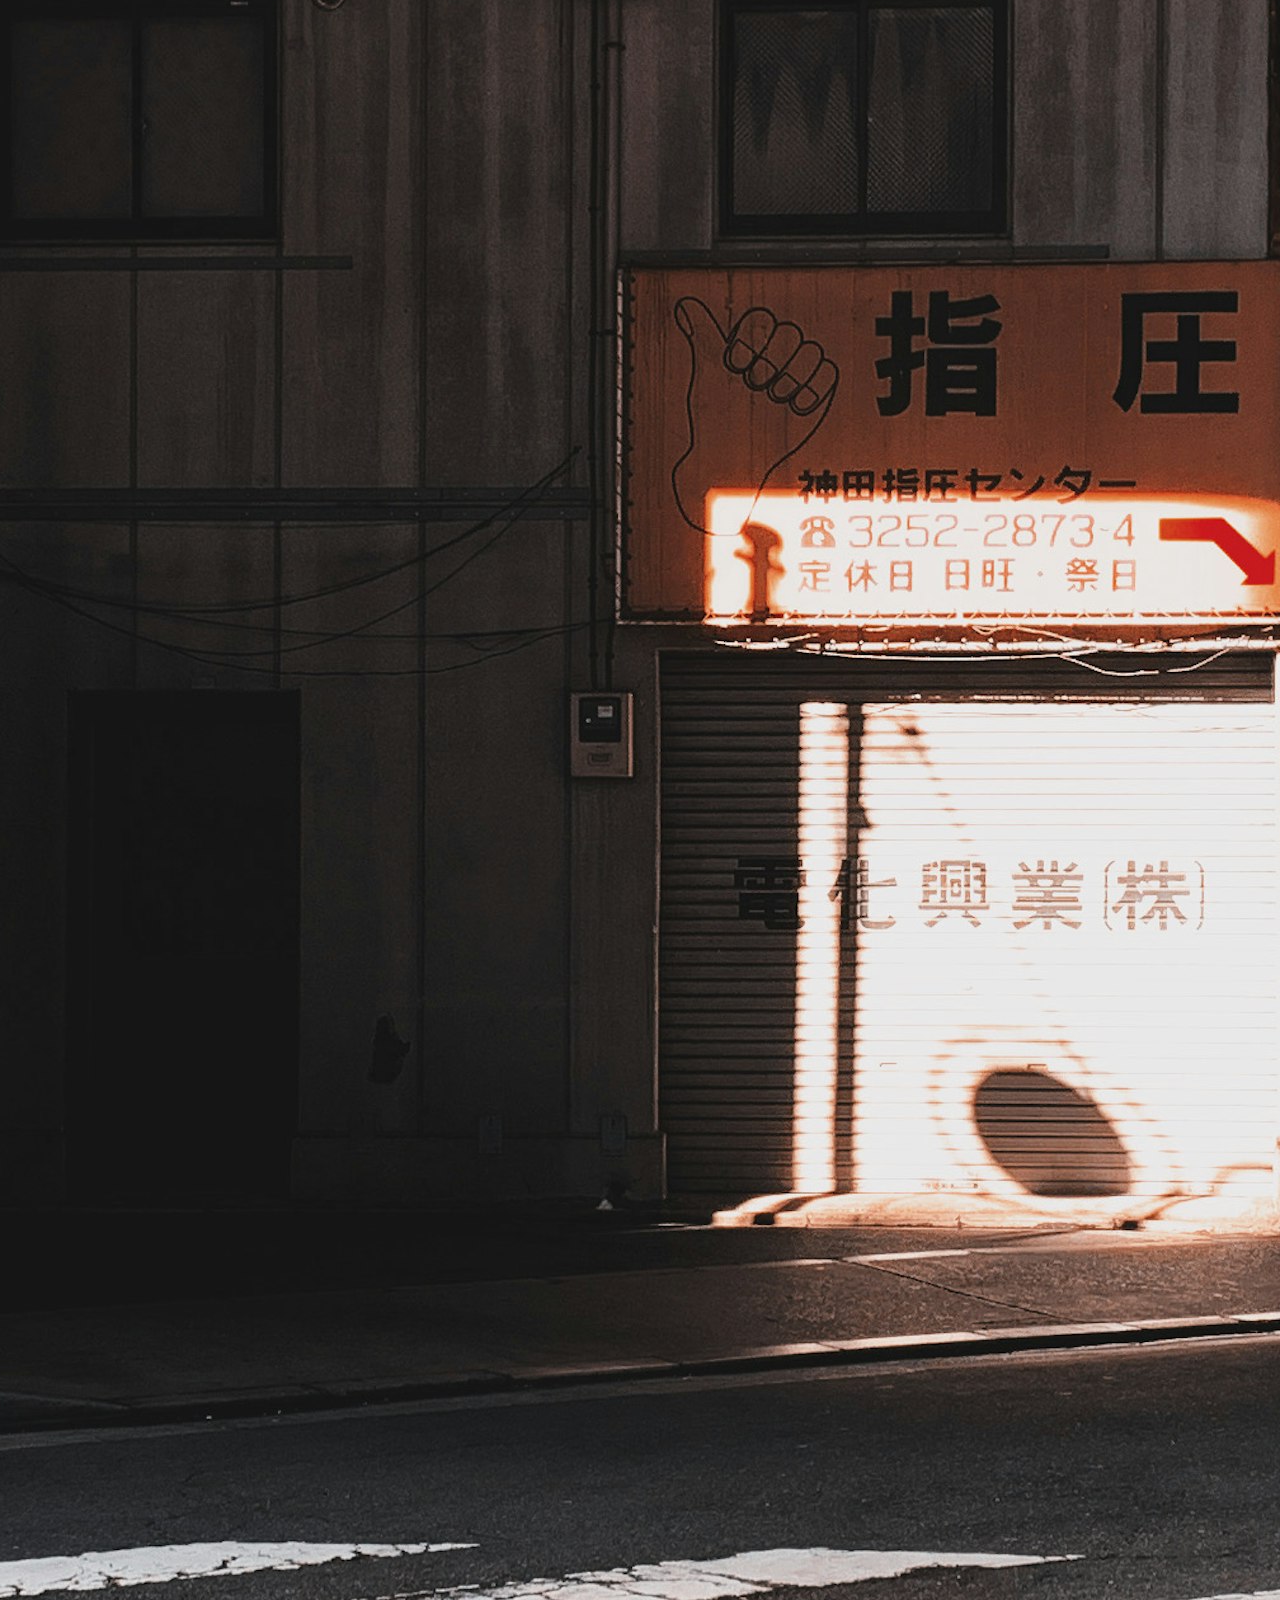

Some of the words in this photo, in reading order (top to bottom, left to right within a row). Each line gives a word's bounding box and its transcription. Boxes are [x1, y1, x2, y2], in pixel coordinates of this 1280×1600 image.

[875, 290, 1239, 417] 指圧
[798, 466, 1137, 504] 神田指圧センター
[798, 559, 913, 593] 定休日
